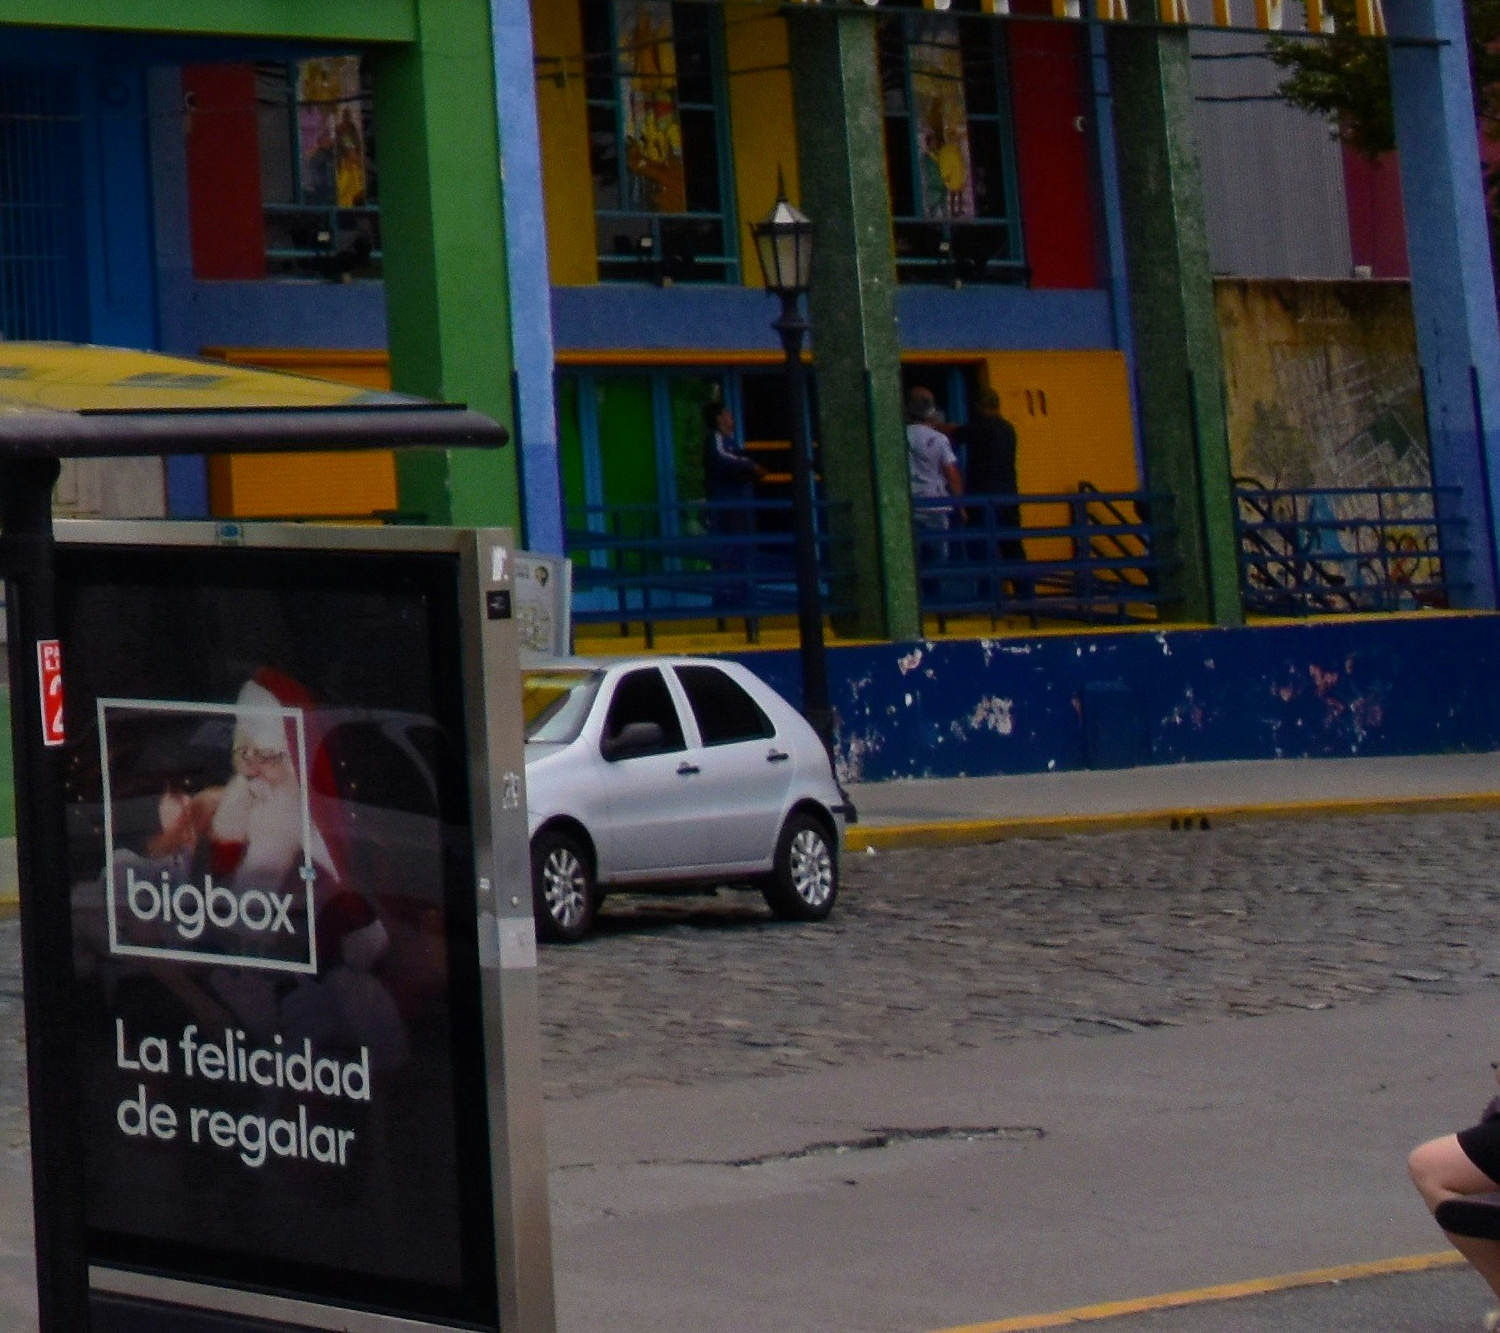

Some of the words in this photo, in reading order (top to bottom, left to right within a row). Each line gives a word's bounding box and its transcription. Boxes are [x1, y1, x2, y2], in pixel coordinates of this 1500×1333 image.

[126, 868, 295, 940] bigbox
[115, 1018, 169, 1074] La
[182, 1022, 371, 1102] felicidad
[116, 1086, 179, 1140] de
[190, 1104, 355, 1168] regalar
